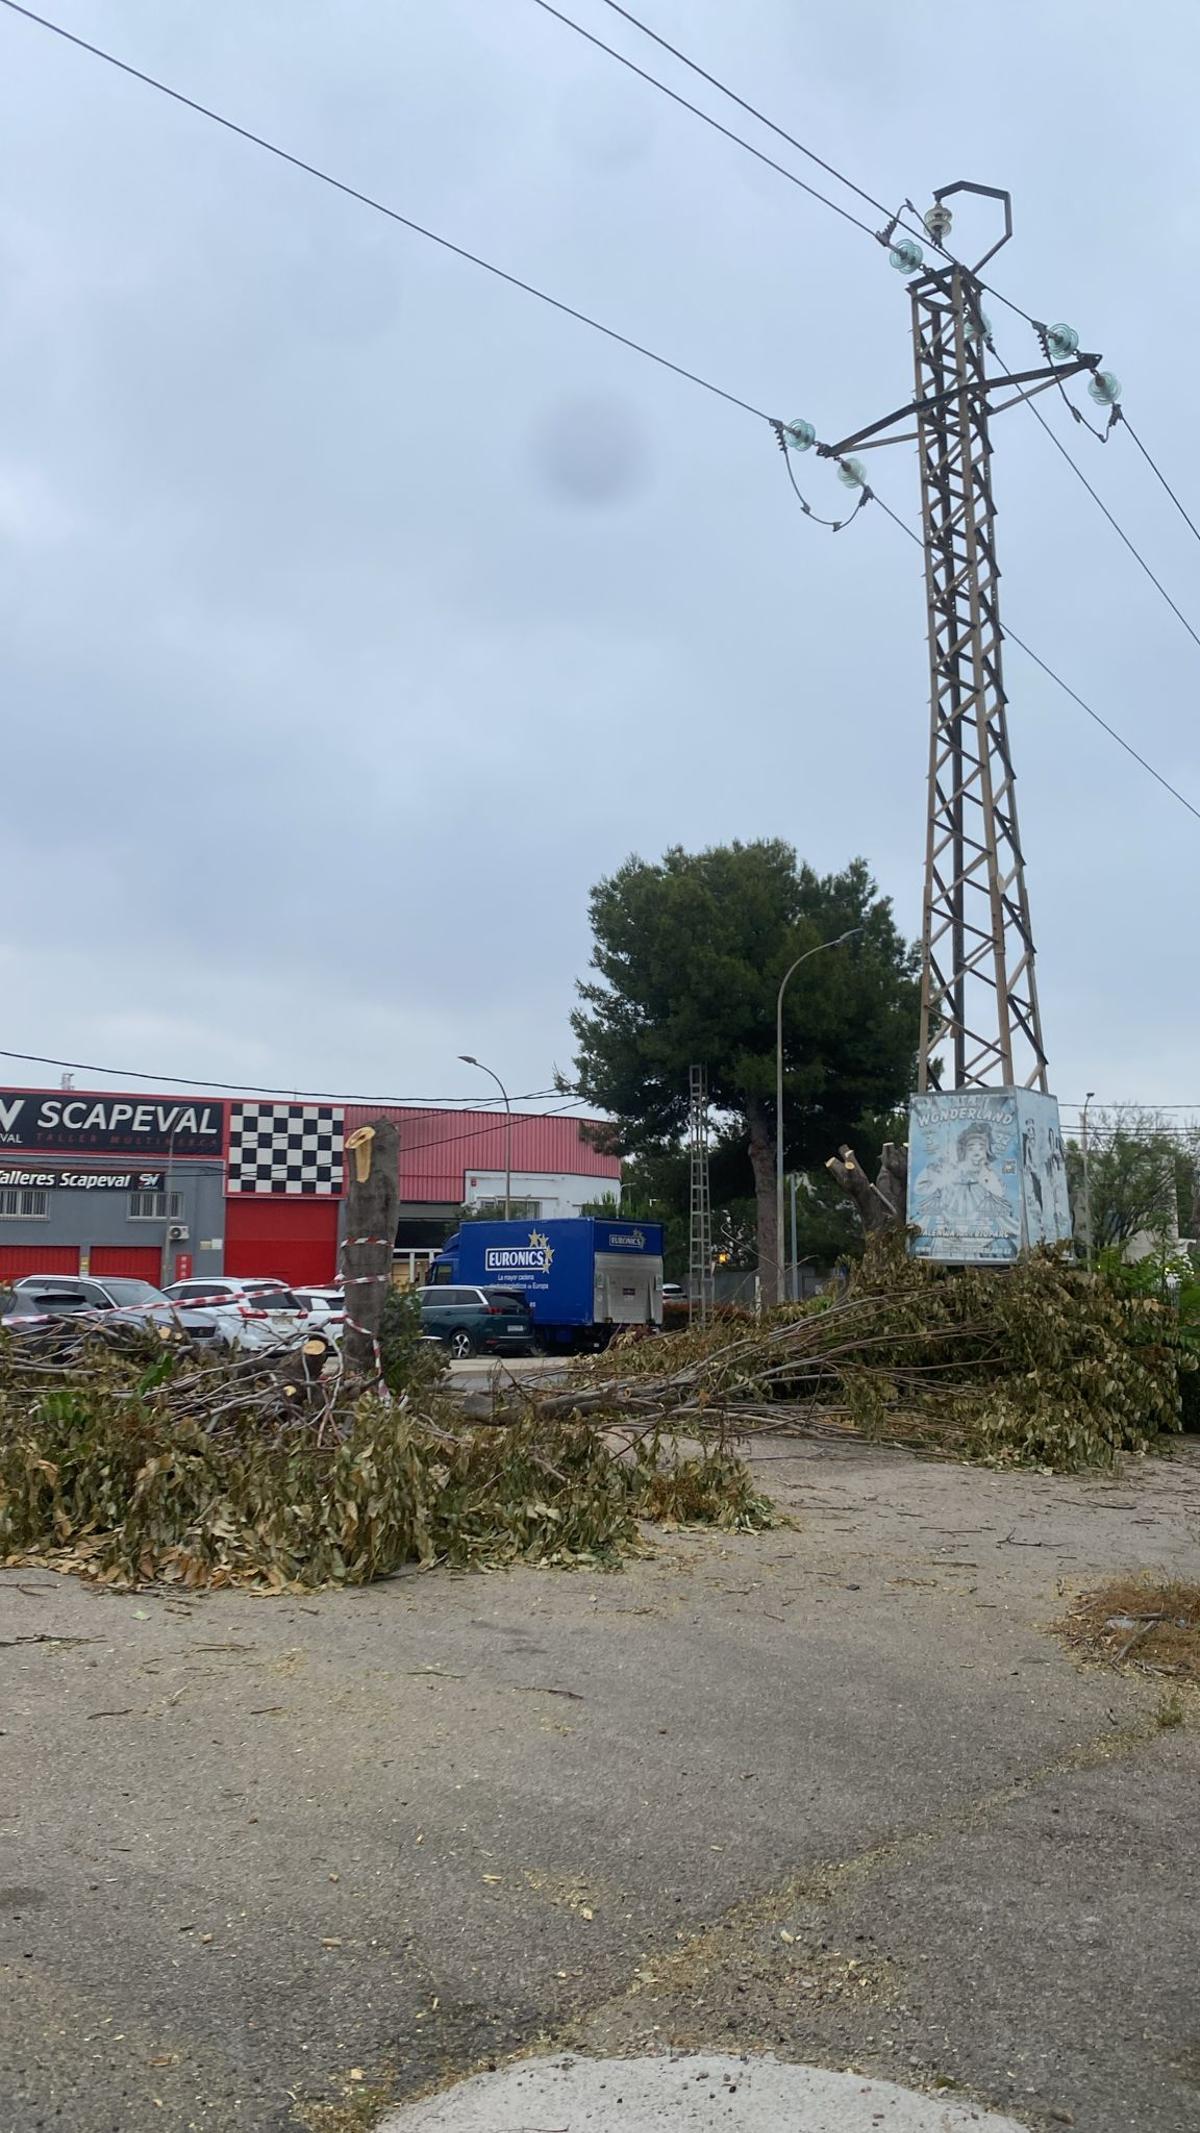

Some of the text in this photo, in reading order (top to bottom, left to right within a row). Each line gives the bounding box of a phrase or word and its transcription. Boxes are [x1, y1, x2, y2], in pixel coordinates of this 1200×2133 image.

[37, 1101, 218, 1134] SCAPEVAL
[918, 1107, 1013, 1127] WONDERLAND
[35, 1133, 97, 1143] TALLER
[59, 1173, 131, 1189] Scapeval
[489, 1251, 544, 1267] EURONICS
